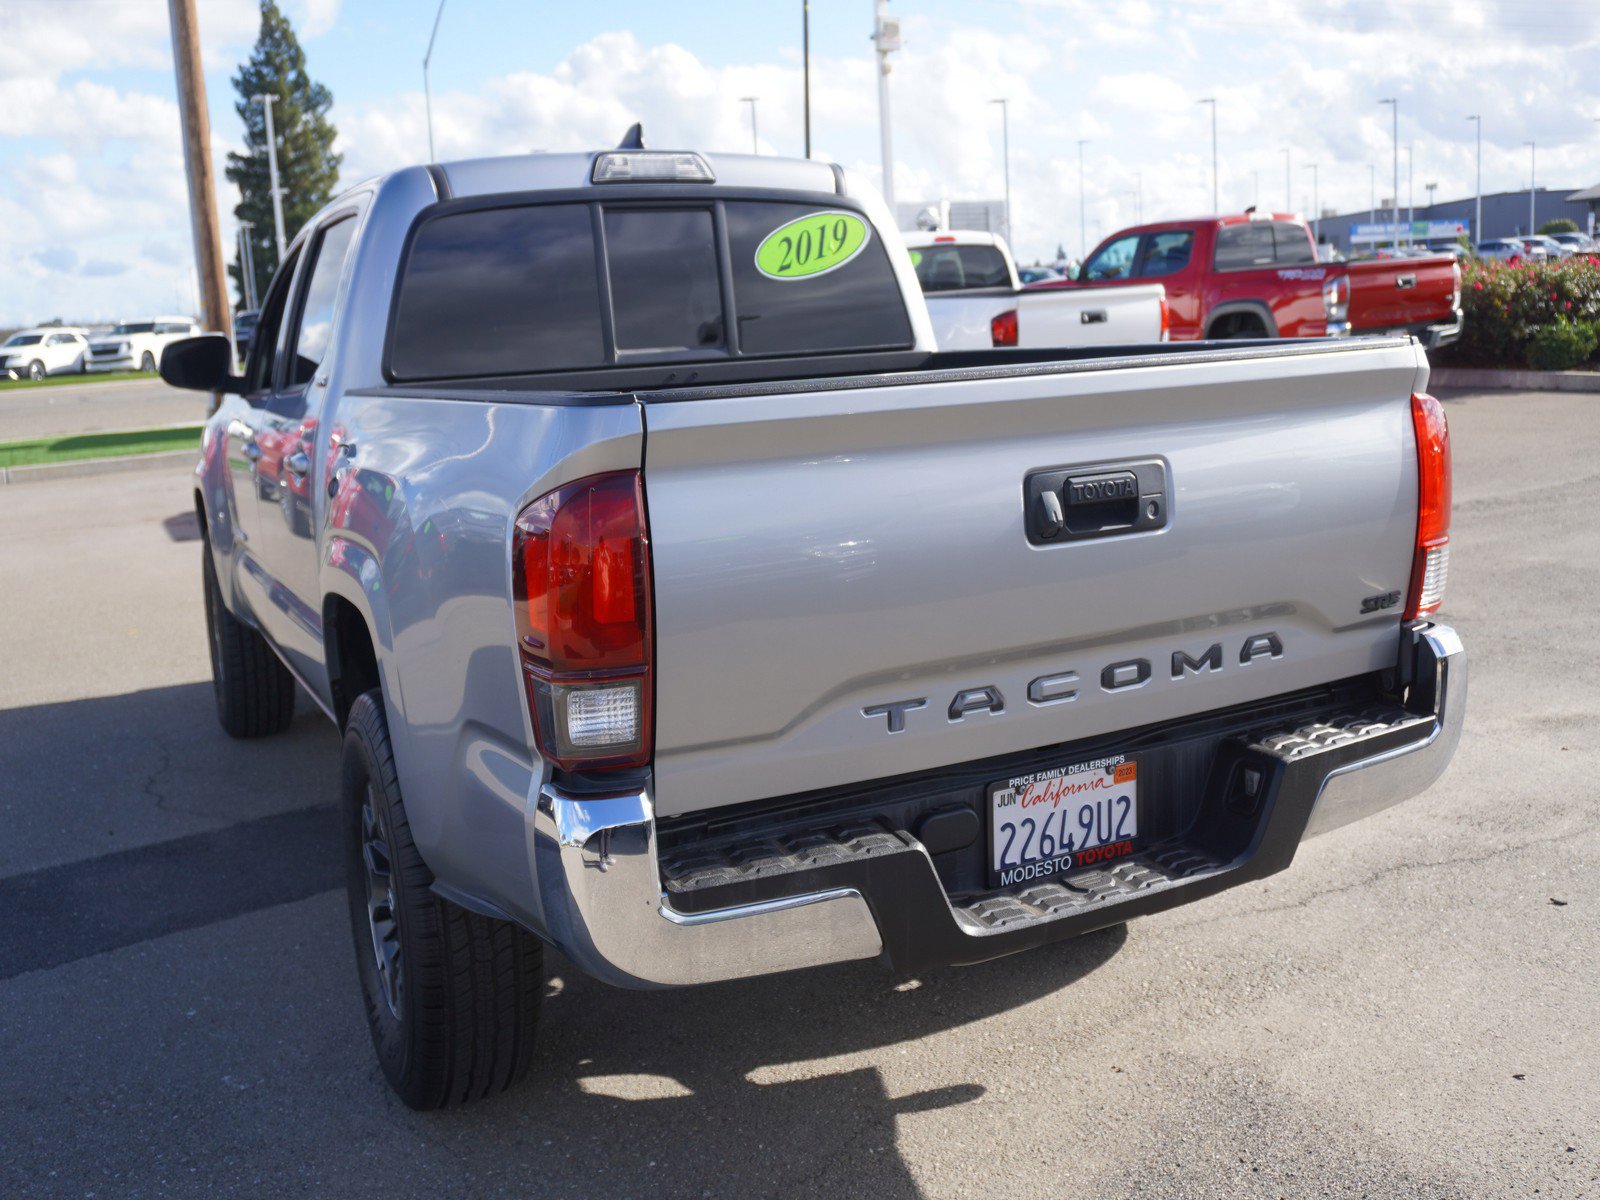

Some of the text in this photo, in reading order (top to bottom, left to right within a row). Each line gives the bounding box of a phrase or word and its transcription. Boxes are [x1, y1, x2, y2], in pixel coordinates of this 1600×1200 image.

[777, 219, 848, 272] 2019
[1073, 478, 1135, 500] TOYOTA
[860, 631, 1285, 735] TACOMA
[1009, 755, 1126, 788] PRICE FAMILY DEALERSHIPS
[1021, 771, 1114, 809] California
[1118, 767, 1133, 778] 2023
[997, 792, 1017, 808] JUN
[1000, 795, 1132, 868] 22649U2
[1001, 841, 1133, 887] MODESTO TOYOTA
